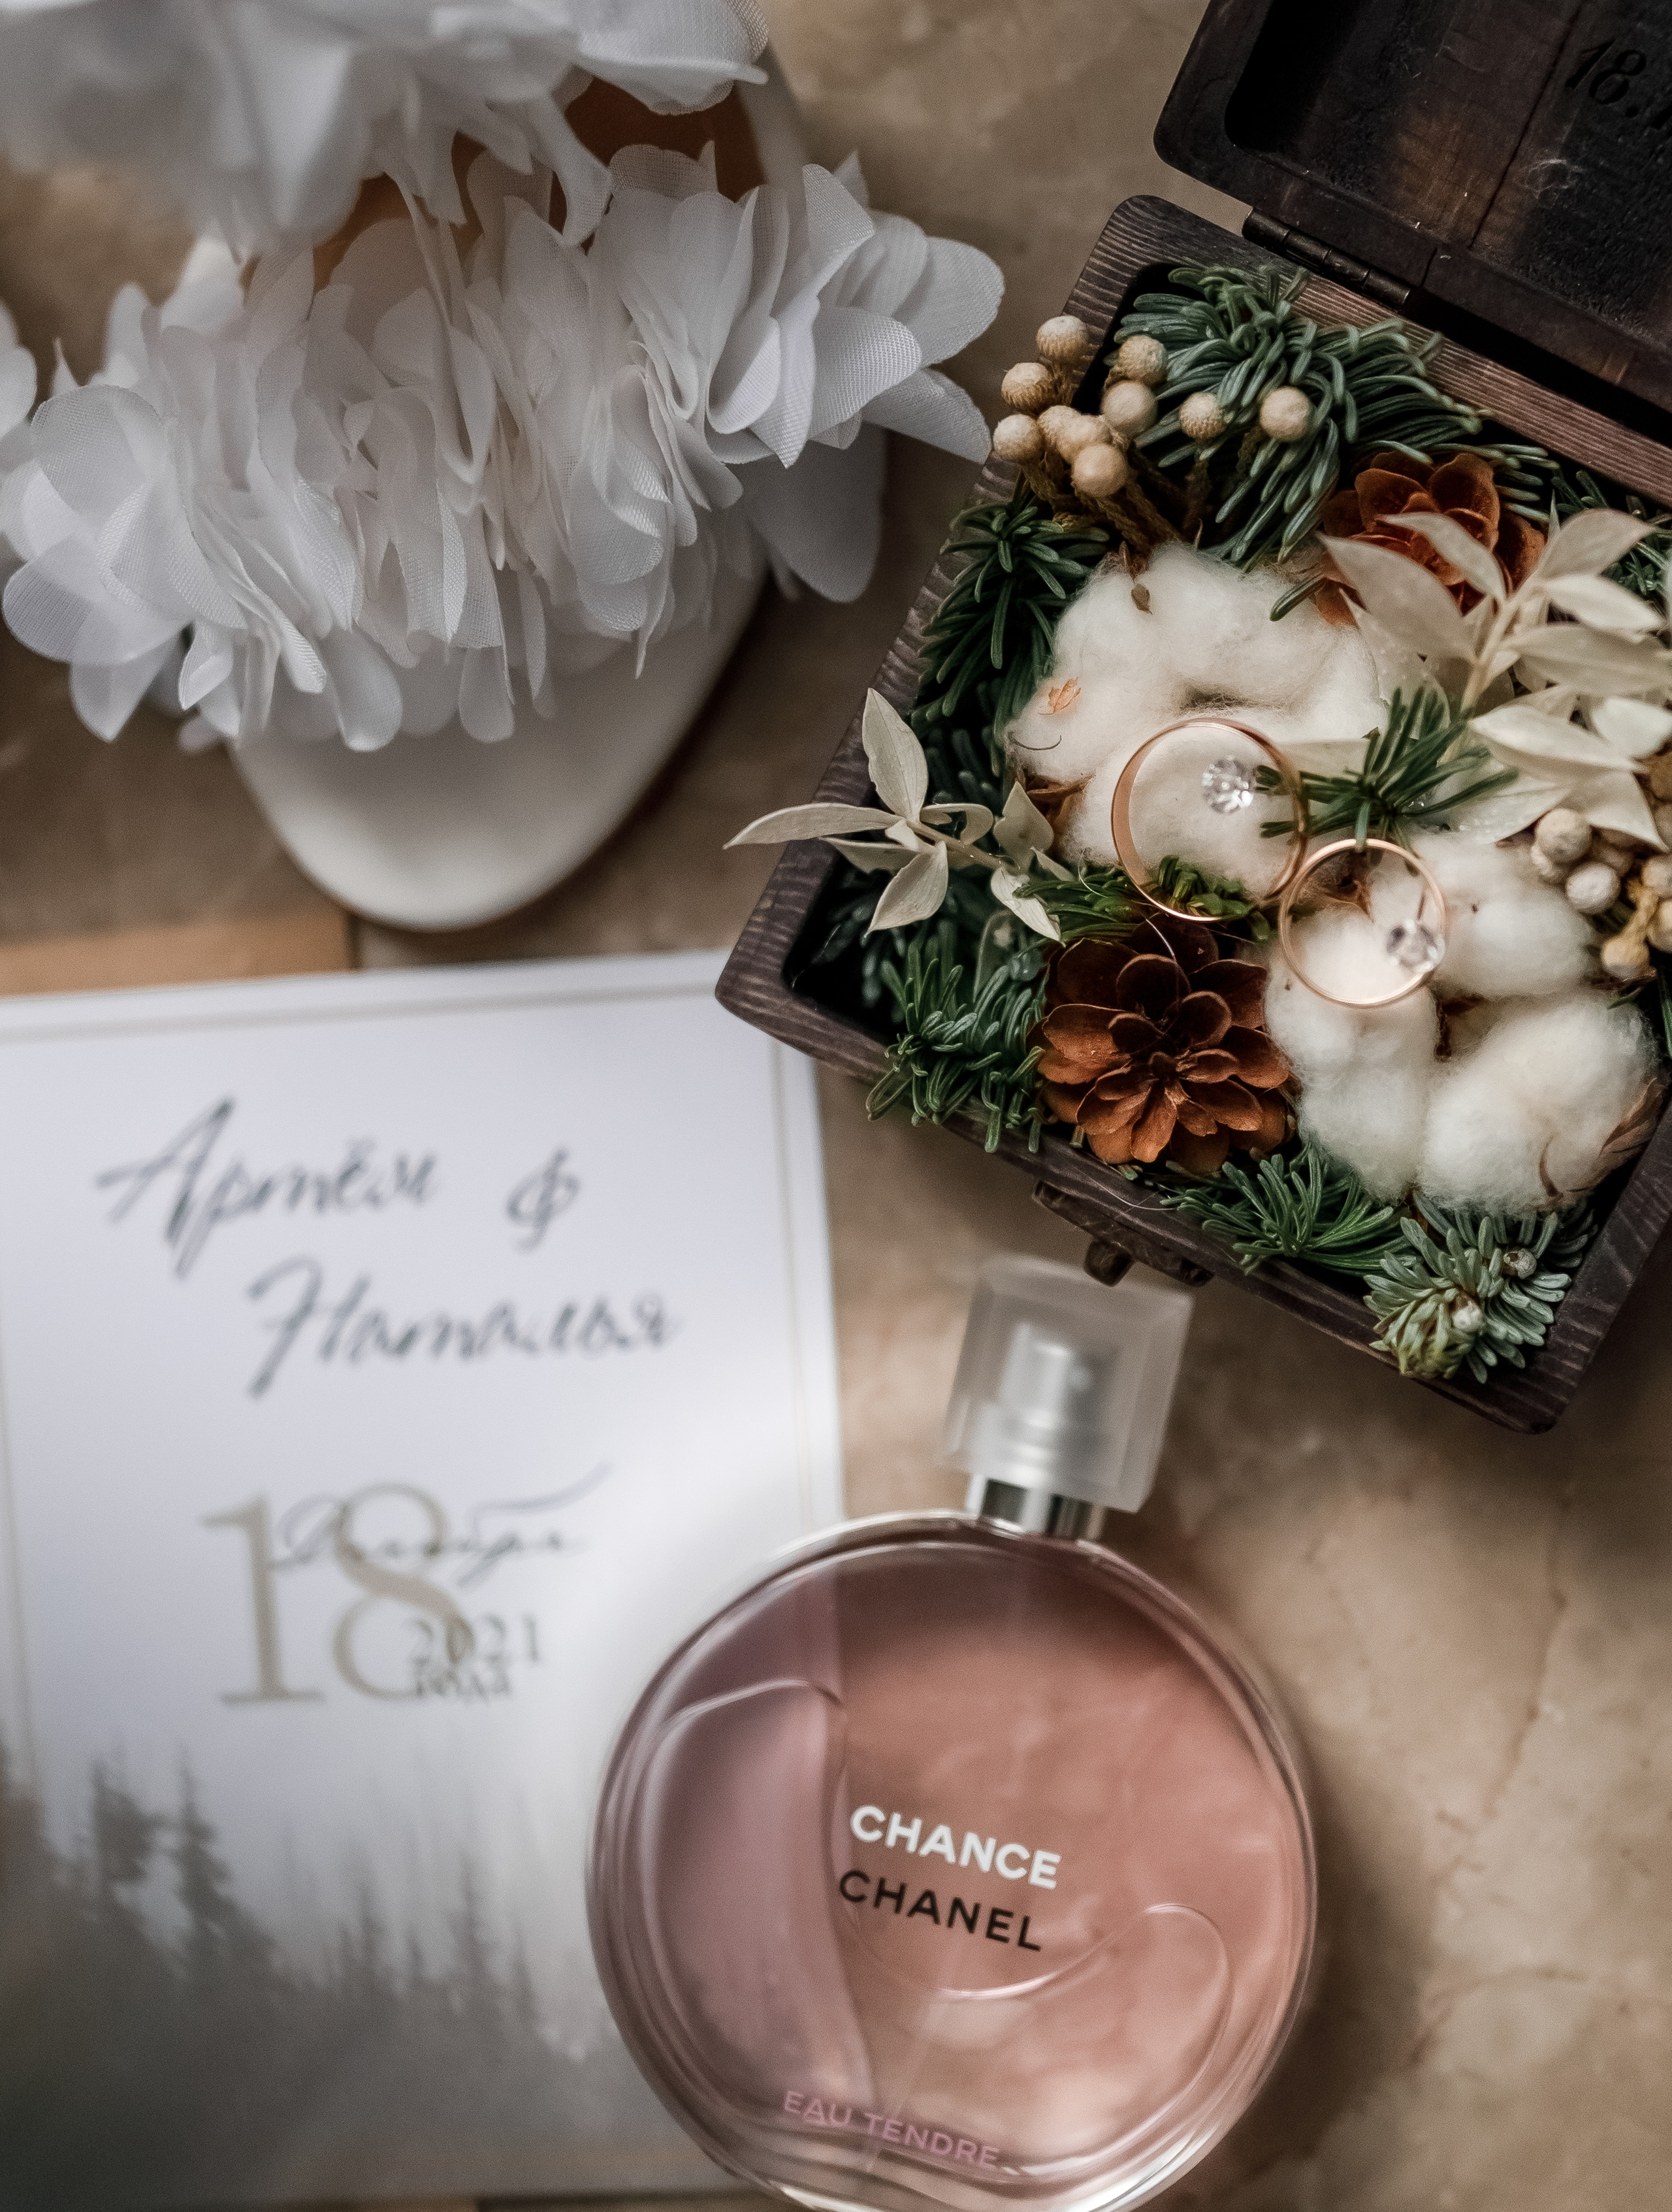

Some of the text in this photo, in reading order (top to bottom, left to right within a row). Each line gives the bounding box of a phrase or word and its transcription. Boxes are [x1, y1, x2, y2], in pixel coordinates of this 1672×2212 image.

[246, 1253, 679, 1399] Наталья
[199, 1477, 475, 1707] 18
[404, 1611, 541, 1665] 2021
[850, 1804, 1061, 1890] CHANCE
[839, 1870, 1042, 1951] CHANEL
[784, 2089, 1001, 2170] EAU TENDRE
